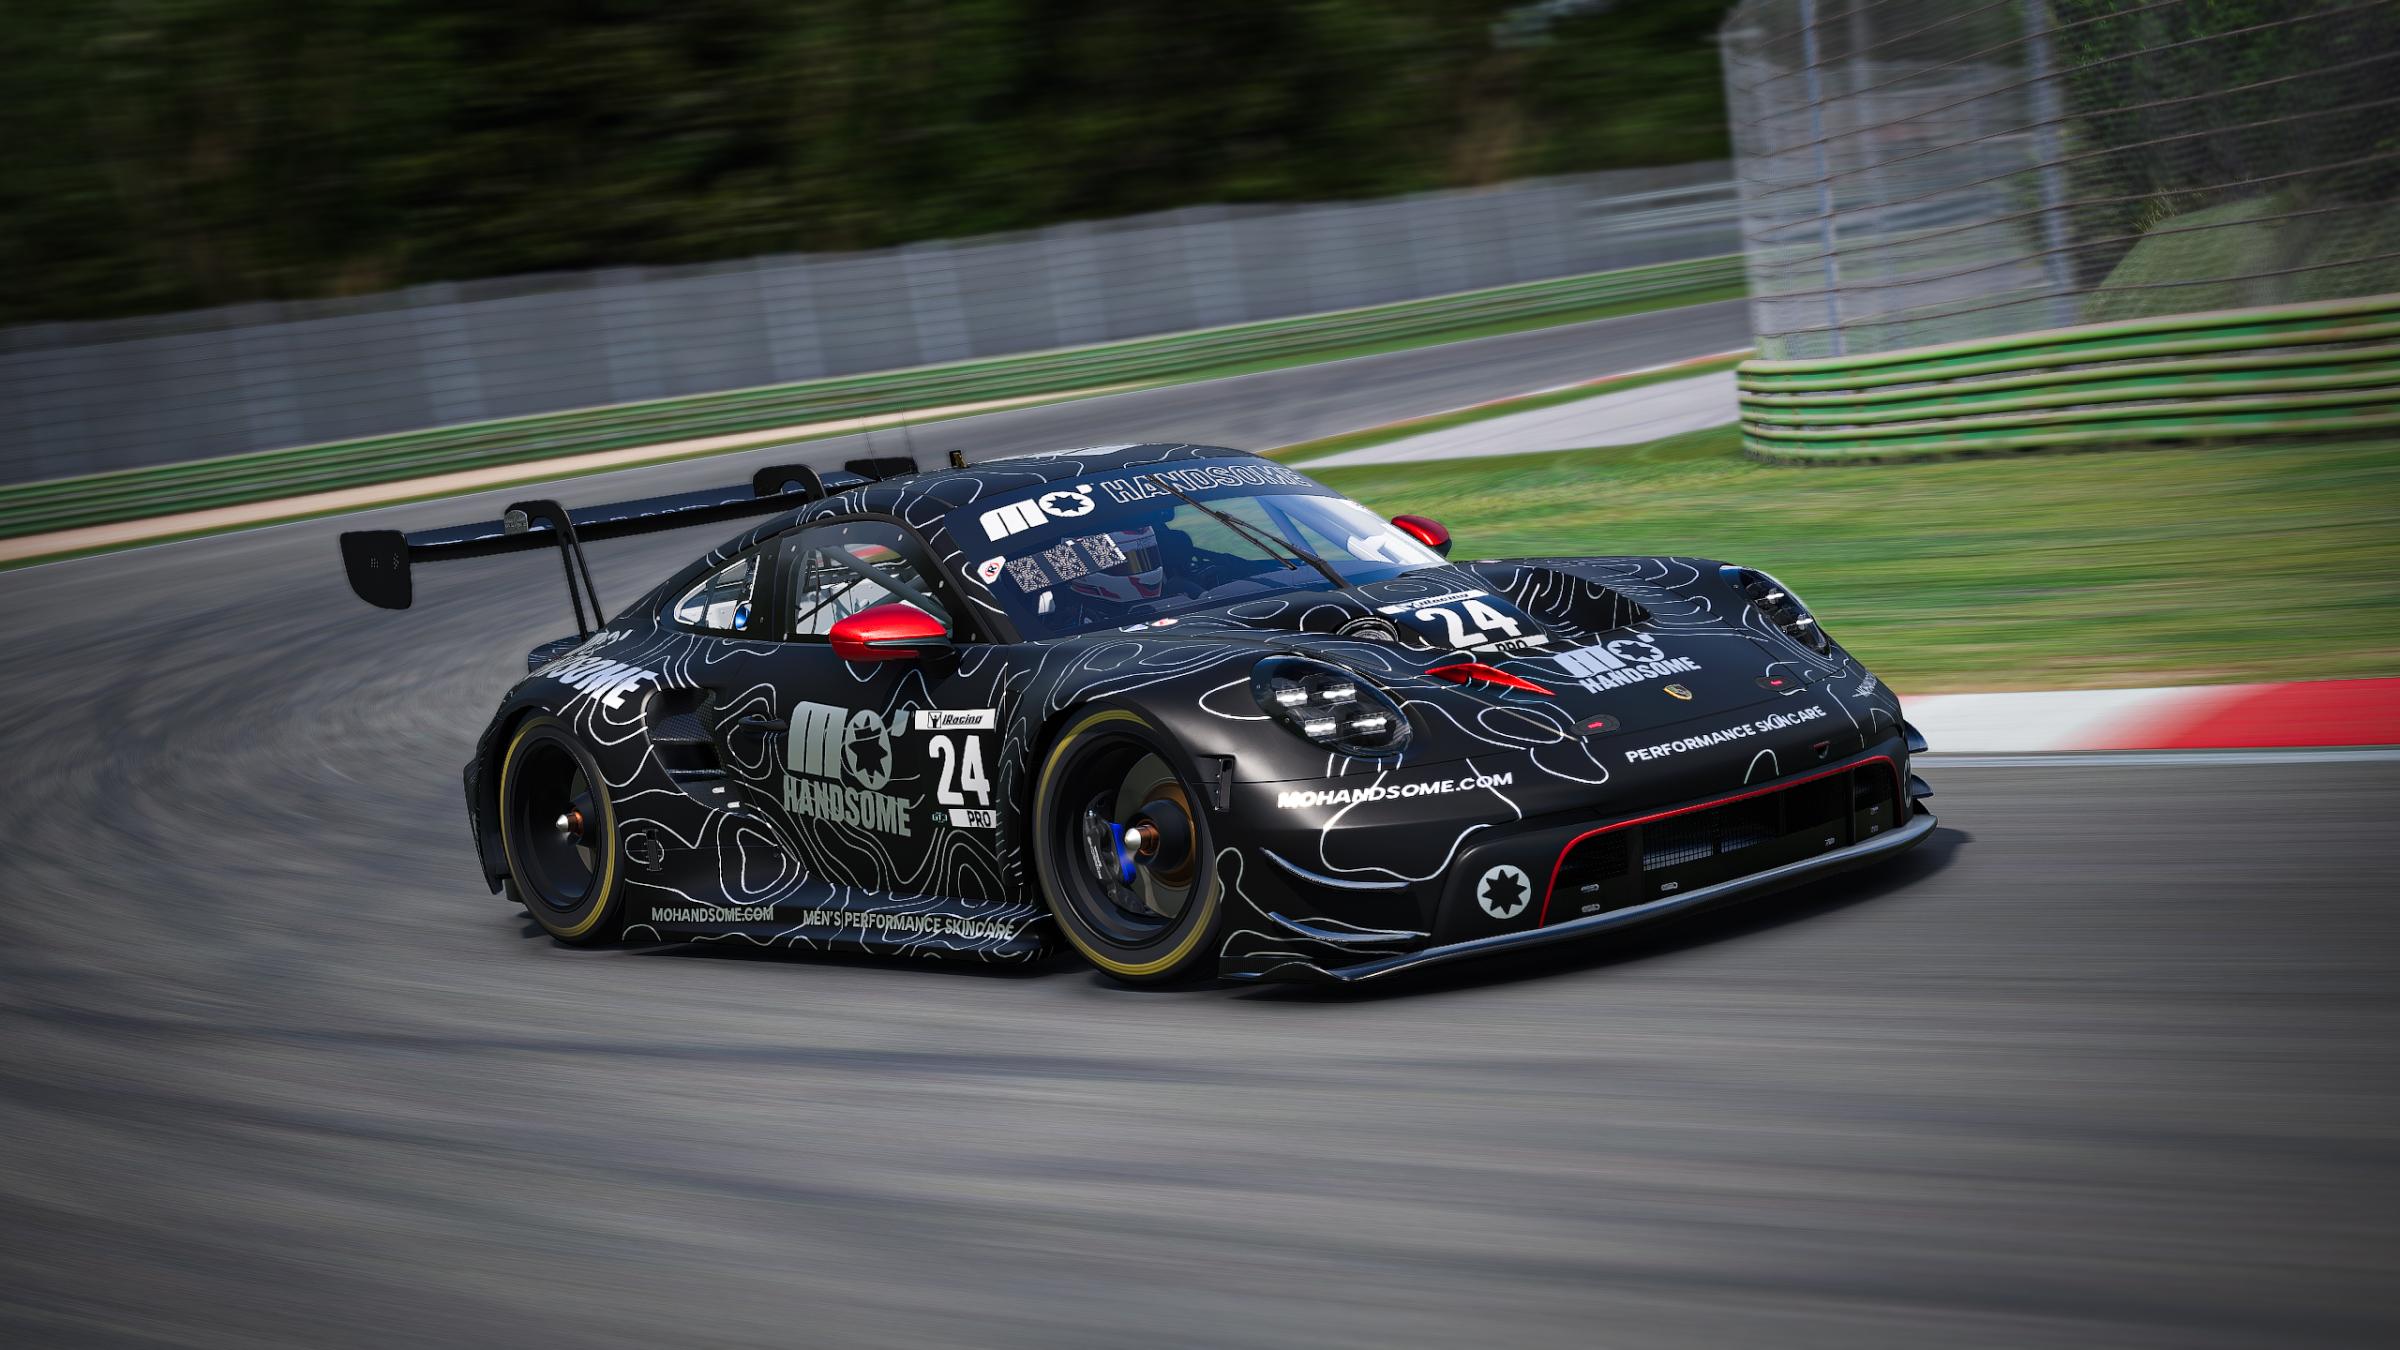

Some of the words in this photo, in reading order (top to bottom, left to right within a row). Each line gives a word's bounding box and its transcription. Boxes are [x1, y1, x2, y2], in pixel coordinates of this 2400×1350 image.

[1100, 465, 1312, 503] HANDSOME
[1415, 600, 1522, 649] 24
[1578, 656, 1702, 694] HANDSOME
[1624, 724, 1756, 763] PERFORMANCE
[1755, 705, 1828, 733] SKINCARE
[928, 734, 990, 806] 24
[783, 774, 912, 838] HANDSOME
[1277, 772, 1513, 809] MOHANDSOME.COM
[966, 810, 992, 827] PRO
[651, 906, 774, 923] MOHANDSOME.COM
[803, 909, 841, 926] MEN'S
[844, 911, 942, 933] PERFORMANCE
[945, 918, 1016, 941] SKINCARE
